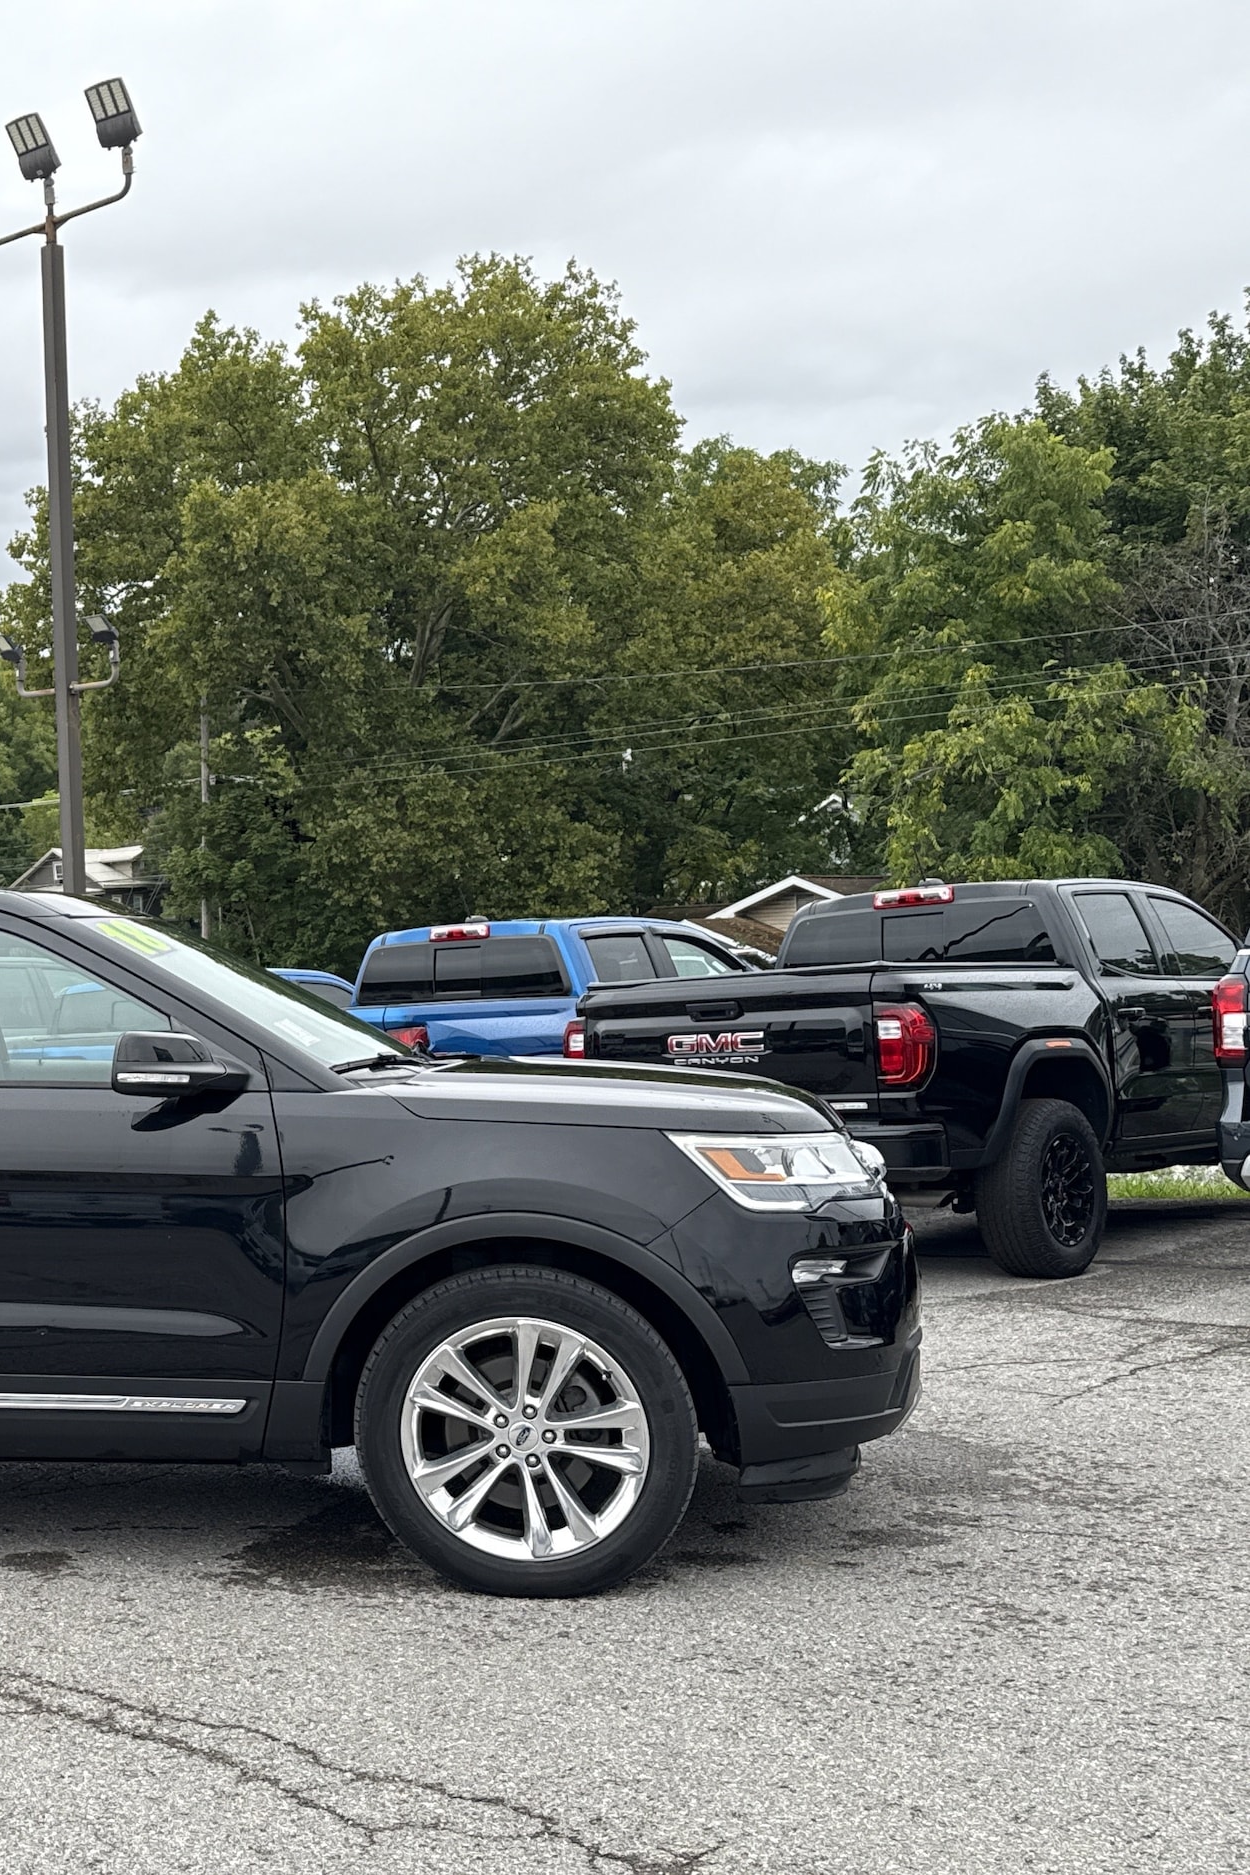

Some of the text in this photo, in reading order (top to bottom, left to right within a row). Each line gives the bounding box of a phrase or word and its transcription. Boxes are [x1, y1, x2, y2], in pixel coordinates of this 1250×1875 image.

[667, 1031, 765, 1054] GMC
[674, 1056, 759, 1065] CANYON
[130, 1401, 237, 1410] EXPLORER
